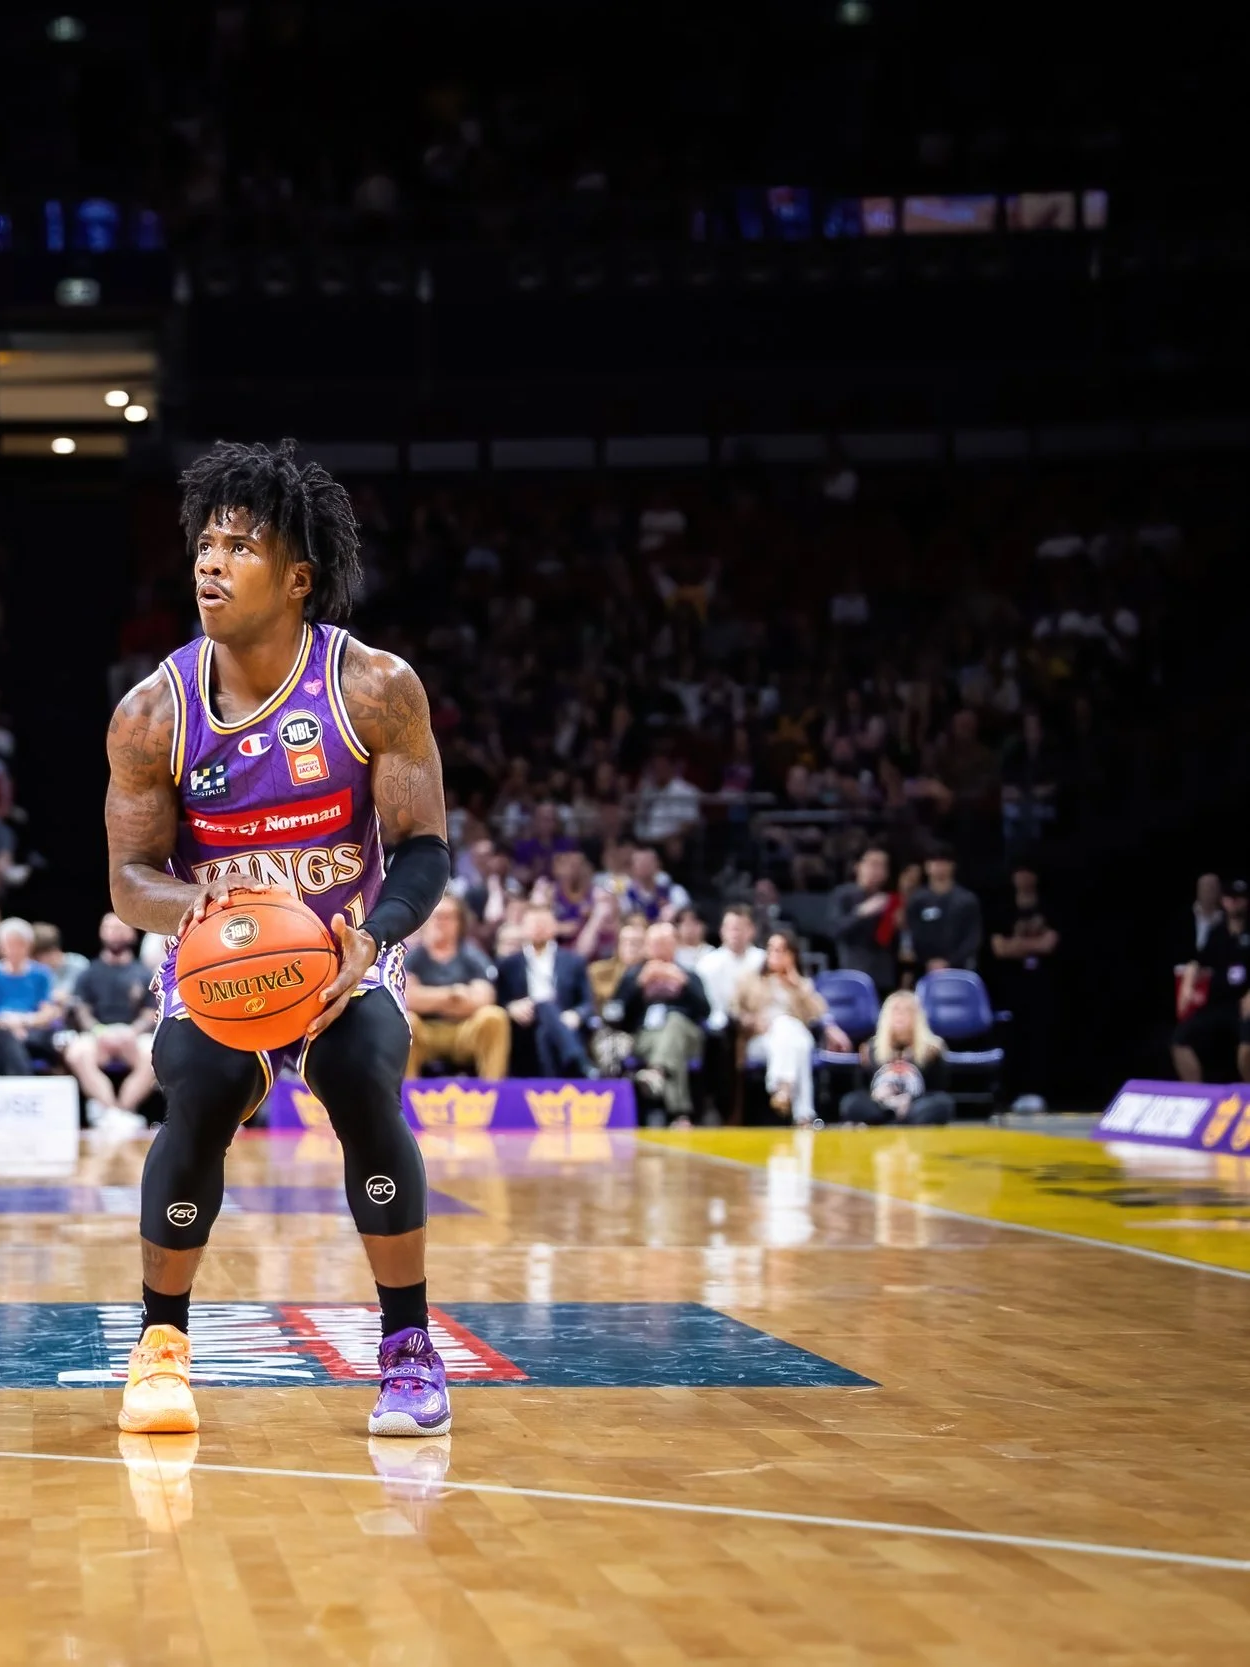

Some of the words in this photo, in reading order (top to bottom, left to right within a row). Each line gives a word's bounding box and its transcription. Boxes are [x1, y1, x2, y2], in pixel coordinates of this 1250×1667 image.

[286, 721, 314, 743] NBL
[264, 804, 342, 833] Norman
[228, 923, 251, 940] NBL
[199, 960, 306, 1005] SPALDING
